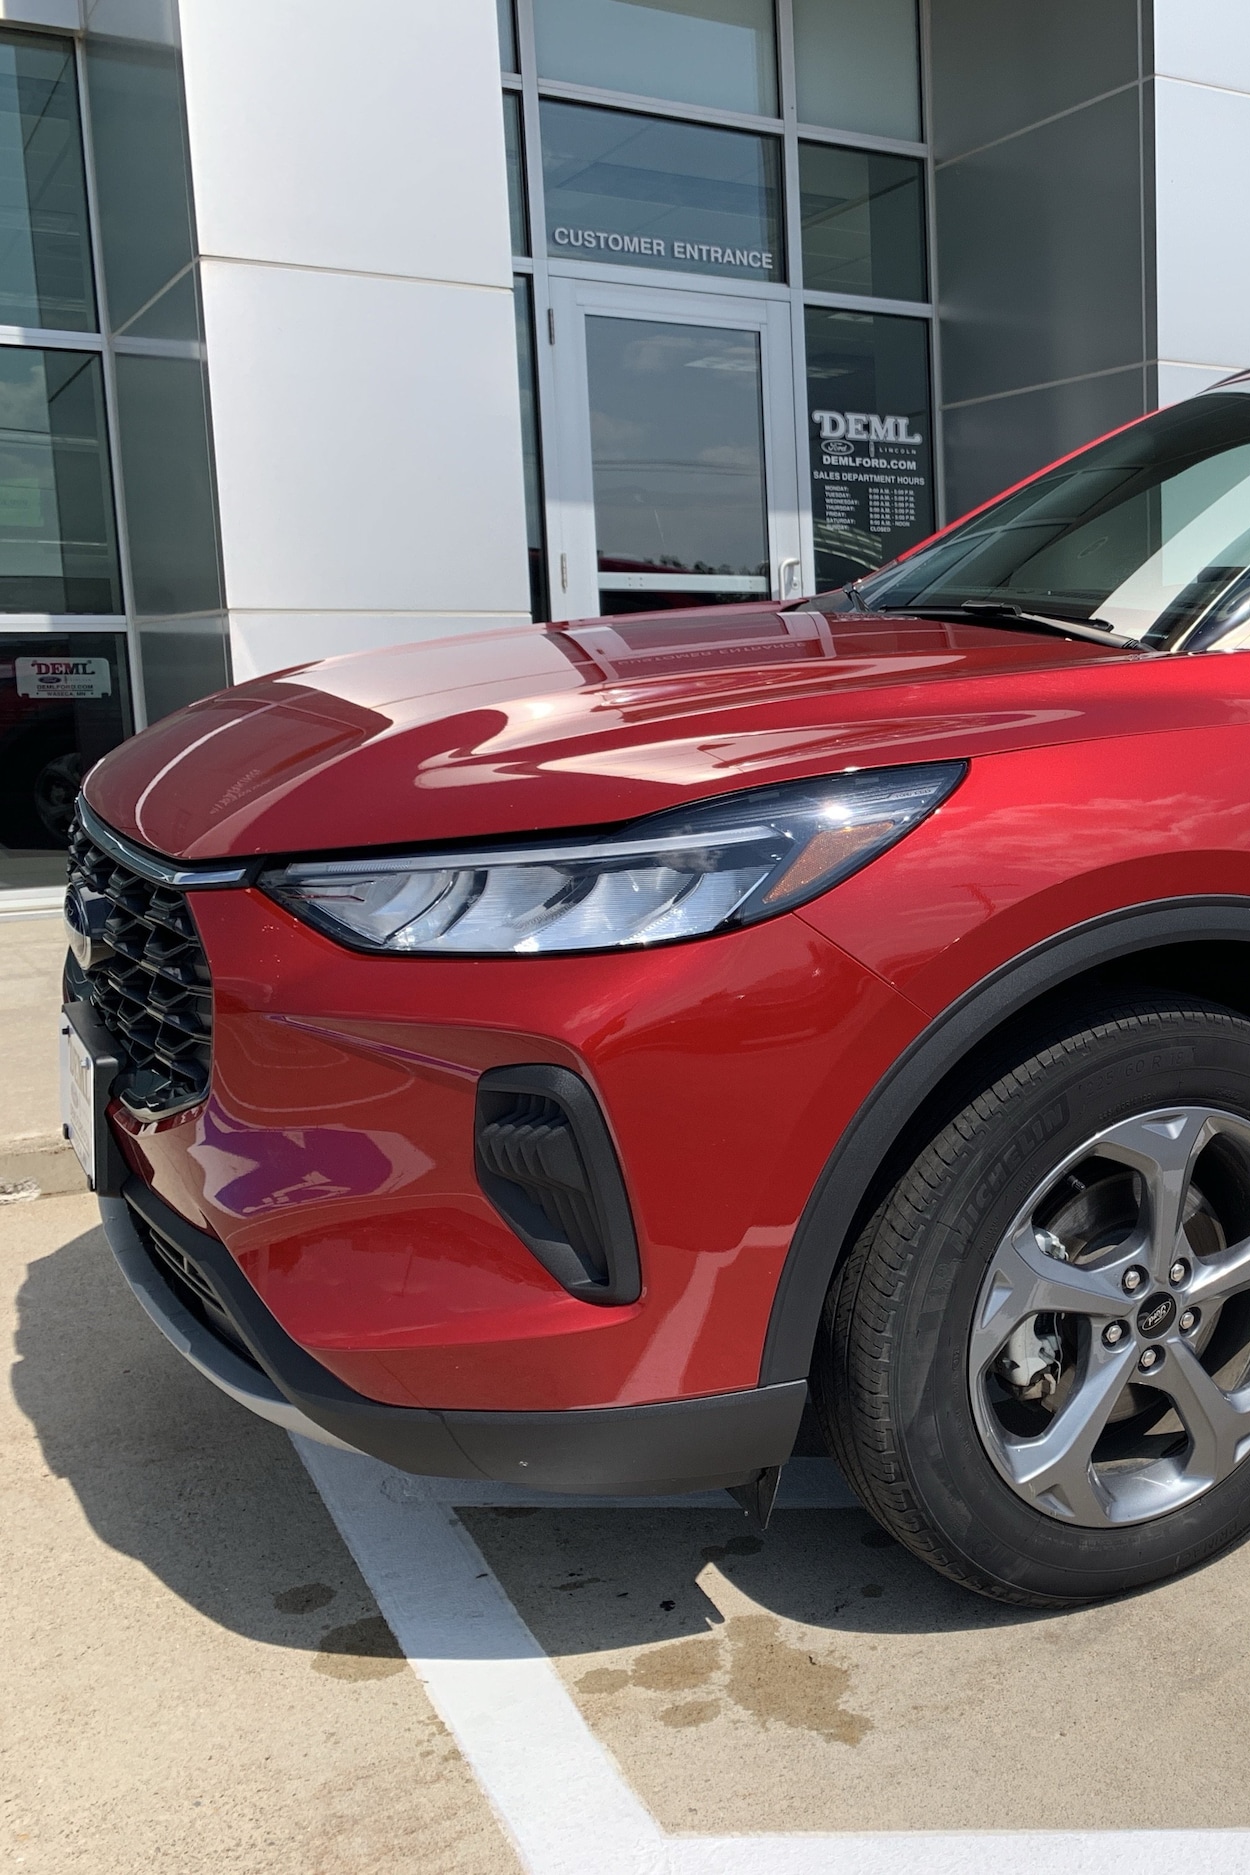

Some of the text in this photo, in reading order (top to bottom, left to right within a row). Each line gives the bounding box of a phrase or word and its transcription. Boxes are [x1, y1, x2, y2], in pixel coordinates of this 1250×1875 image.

[554, 227, 773, 269] CUSTOMER ENTRANCE
[812, 410, 922, 445] DEML
[879, 447, 917, 455] LINCOLN
[822, 455, 917, 470] DEMLFORD.COM
[813, 471, 925, 486] SALES DEPARTMENT HOURS
[31, 662, 95, 675] DEML
[951, 1101, 1065, 1254] MICHELIN
